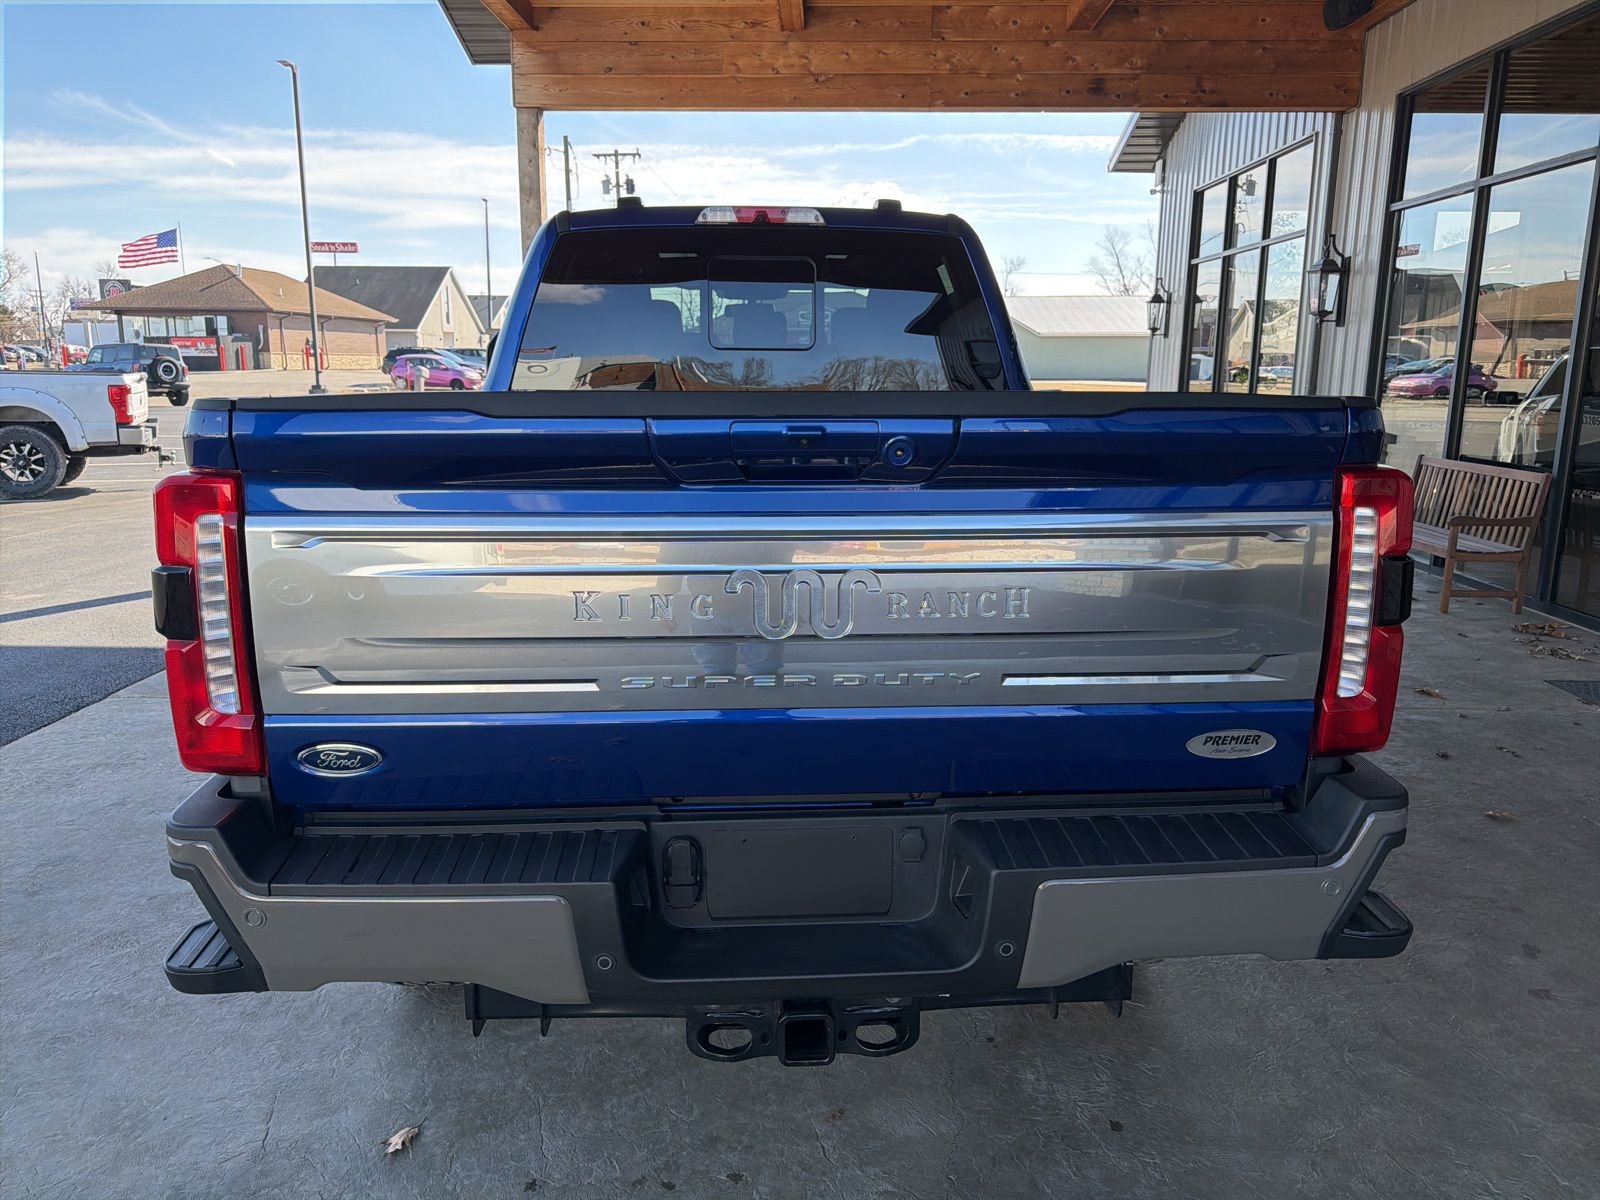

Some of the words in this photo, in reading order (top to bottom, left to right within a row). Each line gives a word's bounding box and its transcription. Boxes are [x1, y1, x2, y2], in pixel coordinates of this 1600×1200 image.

[572, 591, 715, 622] KING
[886, 587, 1031, 619] RANCH
[621, 674, 818, 690] SUPER
[832, 672, 982, 687] DUTY
[1203, 734, 1262, 747] PREMIER
[317, 750, 362, 768] Ford
